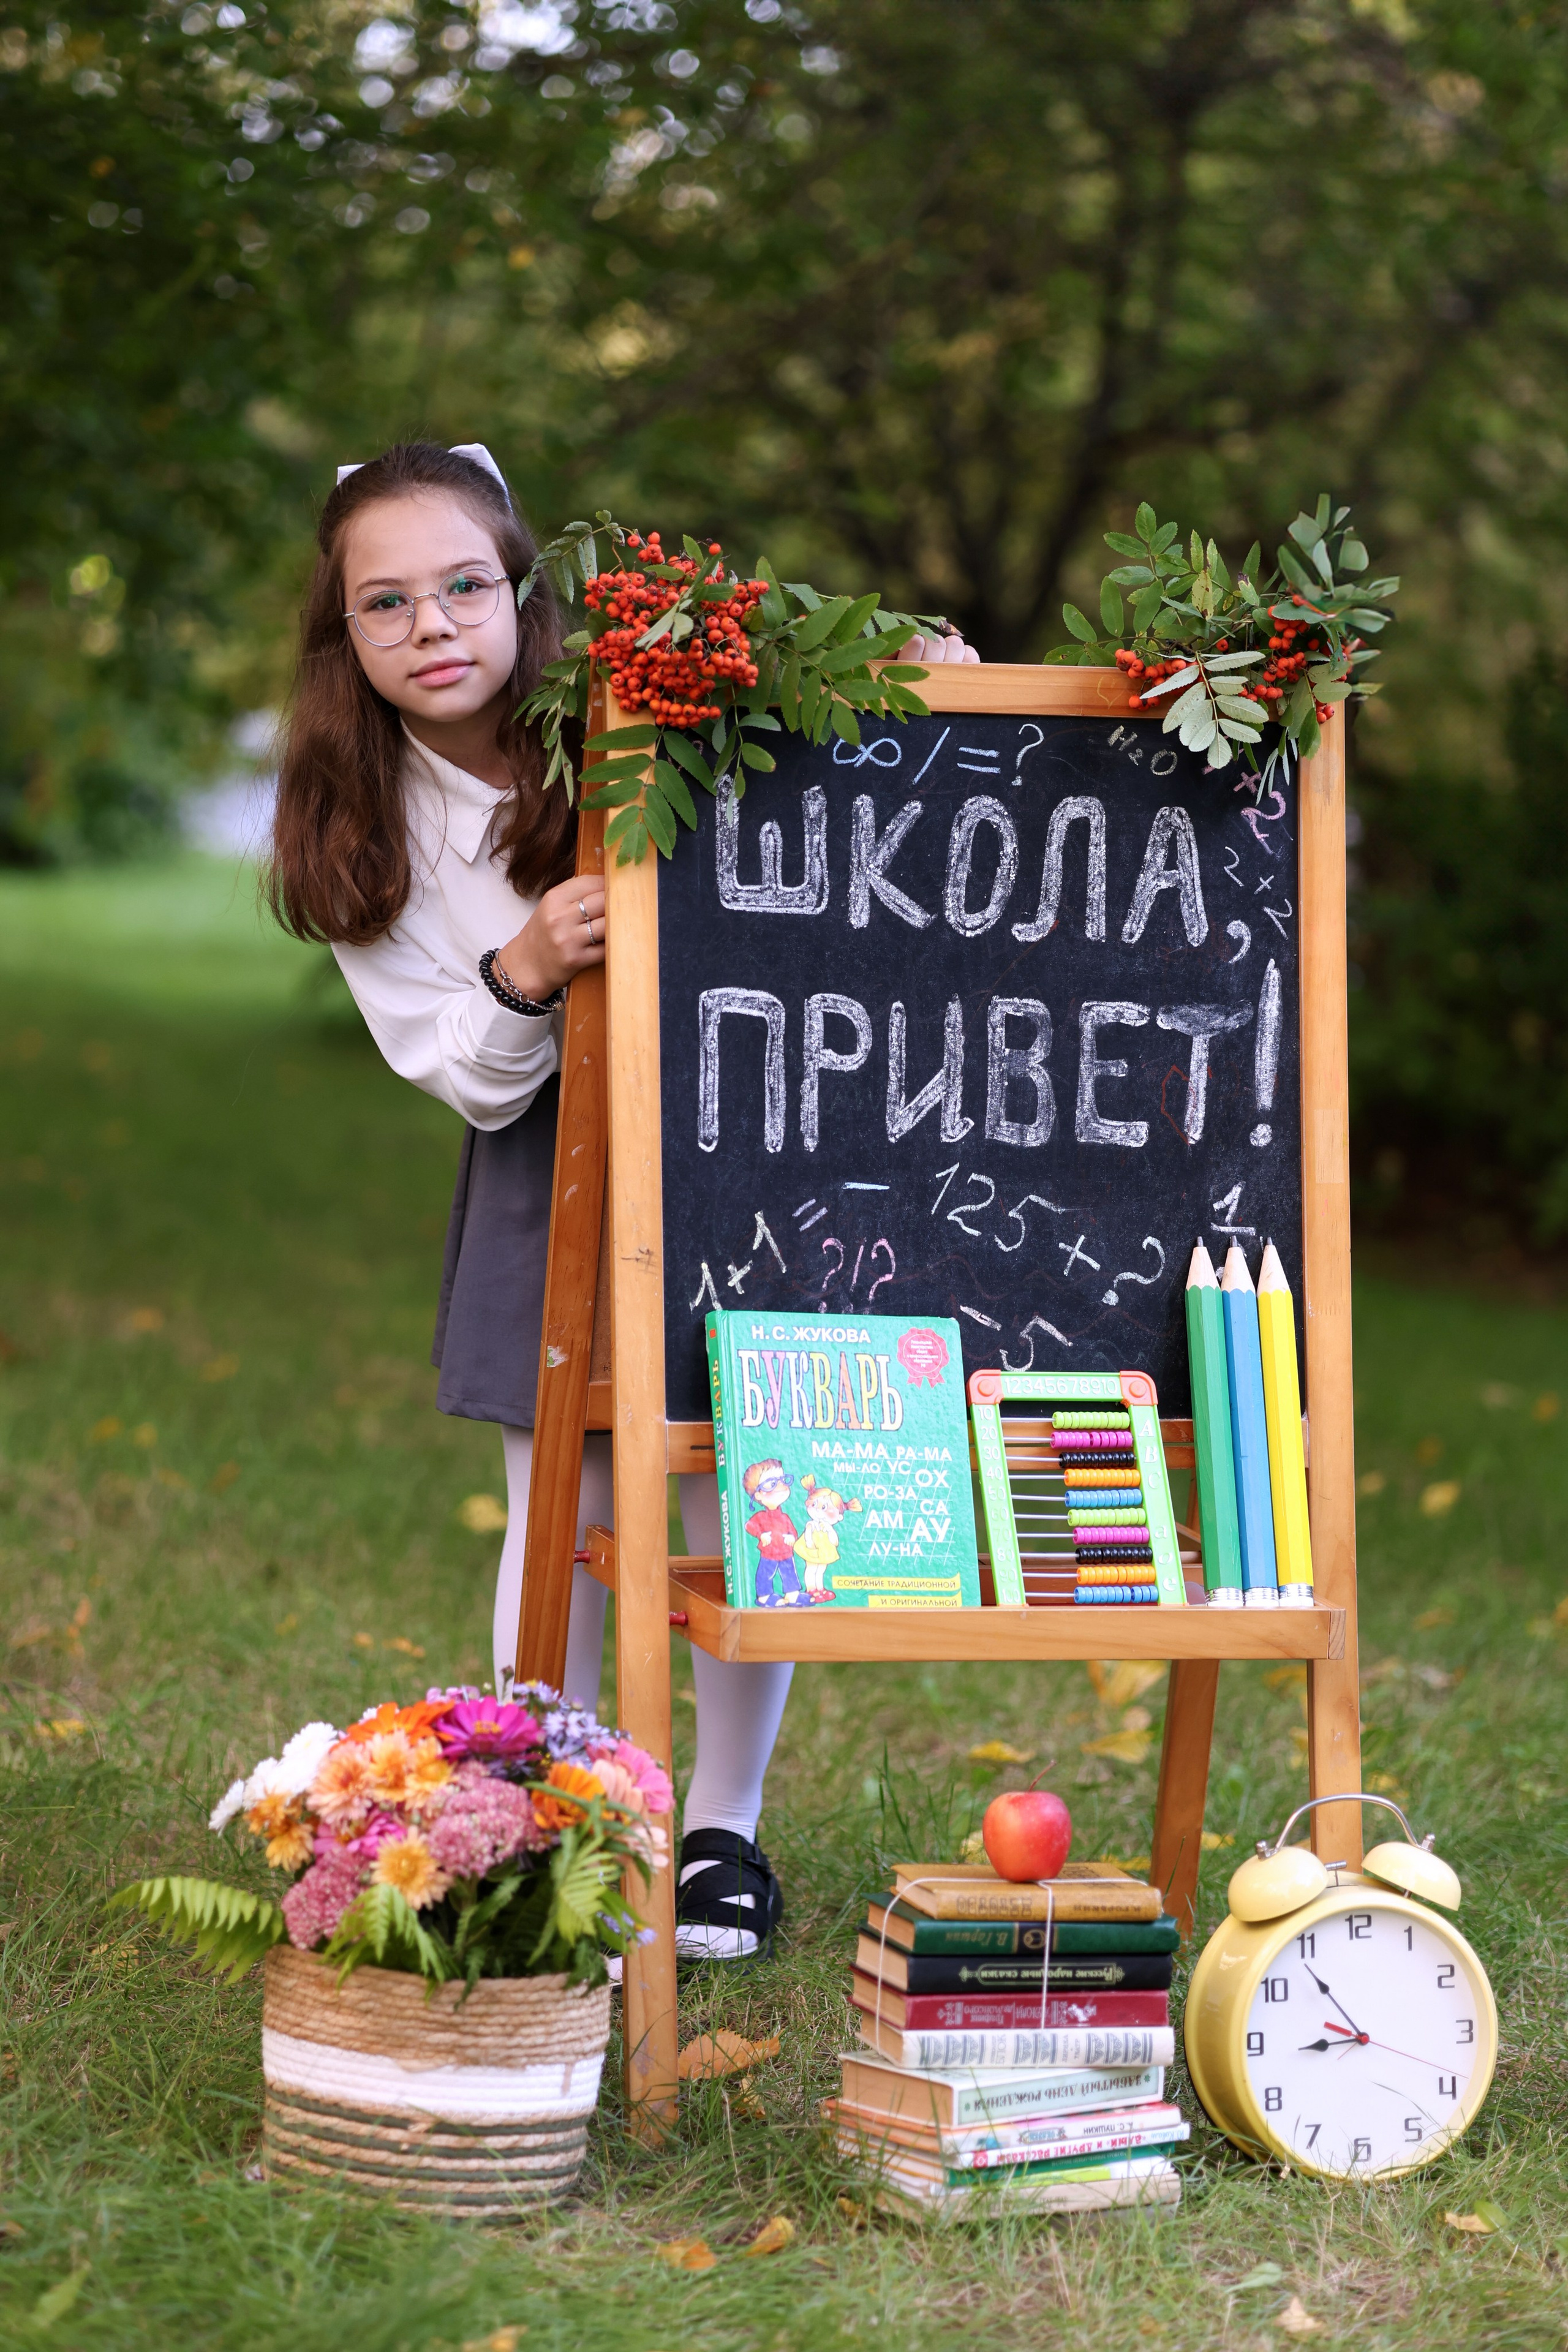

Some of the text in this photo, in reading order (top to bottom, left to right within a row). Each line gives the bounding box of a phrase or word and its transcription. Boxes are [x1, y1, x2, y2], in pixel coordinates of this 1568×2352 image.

[715, 774, 1251, 963] ШКОЛА,
[698, 958, 1283, 1153] ПРИВЕТ!
[793, 1327, 871, 1343] ЖУКОВА
[737, 1349, 904, 1431] БУКВАРЬ
[712, 1359, 726, 1467] БУКВАРЬ
[979, 1407, 993, 1421] 10
[980, 1426, 998, 1441] 20
[1137, 1419, 1154, 1437] A
[812, 1441, 952, 1461] МА-МА РА-МА
[982, 1446, 1000, 1460] 30
[1144, 1445, 1159, 1463] B
[834, 1460, 911, 1475] МЫ-ЛО УС
[986, 1466, 1003, 1480] 40
[914, 1469, 949, 1488] ОХ
[1148, 1472, 1161, 1490] C
[864, 1485, 918, 1499] РО-ЗА
[988, 1485, 1006, 1501] 50
[920, 1499, 949, 1515] СА
[991, 1506, 1009, 1521] 60
[721, 1490, 731, 1558] ЖУКОВА
[865, 1509, 903, 1529] АМ
[910, 1517, 951, 1543] АУ
[869, 1542, 924, 1557] ЛУ-НА
[997, 1547, 1014, 1562] 80
[837, 1578, 956, 1589] СОЧЕТАНИЕ ТРАДИЦИОННОЙ
[999, 1568, 1017, 1583] 90
[890, 1598, 957, 1607] ОРИГИНАЛЬНОЙ
[1001, 1588, 1020, 1604] 100
[1344, 1914, 1372, 1941] 12
[1297, 1932, 1316, 1959] 11
[1404, 1926, 1413, 1951] 1
[981, 1969, 1018, 1979] сказки
[1076, 1967, 1113, 1981] Русские
[1437, 1964, 1455, 1989] 2
[1261, 1977, 1289, 2003] 10
[1456, 2019, 1474, 2044] 3
[1246, 2032, 1264, 2057] 9
[1045, 2084, 1077, 2099] ДЕНЬ
[1439, 2076, 1457, 2100] 4
[1264, 2086, 1283, 2112] 8
[1084, 2124, 1115, 2135] ПУШКИН
[1305, 2124, 1322, 2149] 7
[1404, 2117, 1423, 2143] 5
[1354, 2137, 1372, 2163] 6
